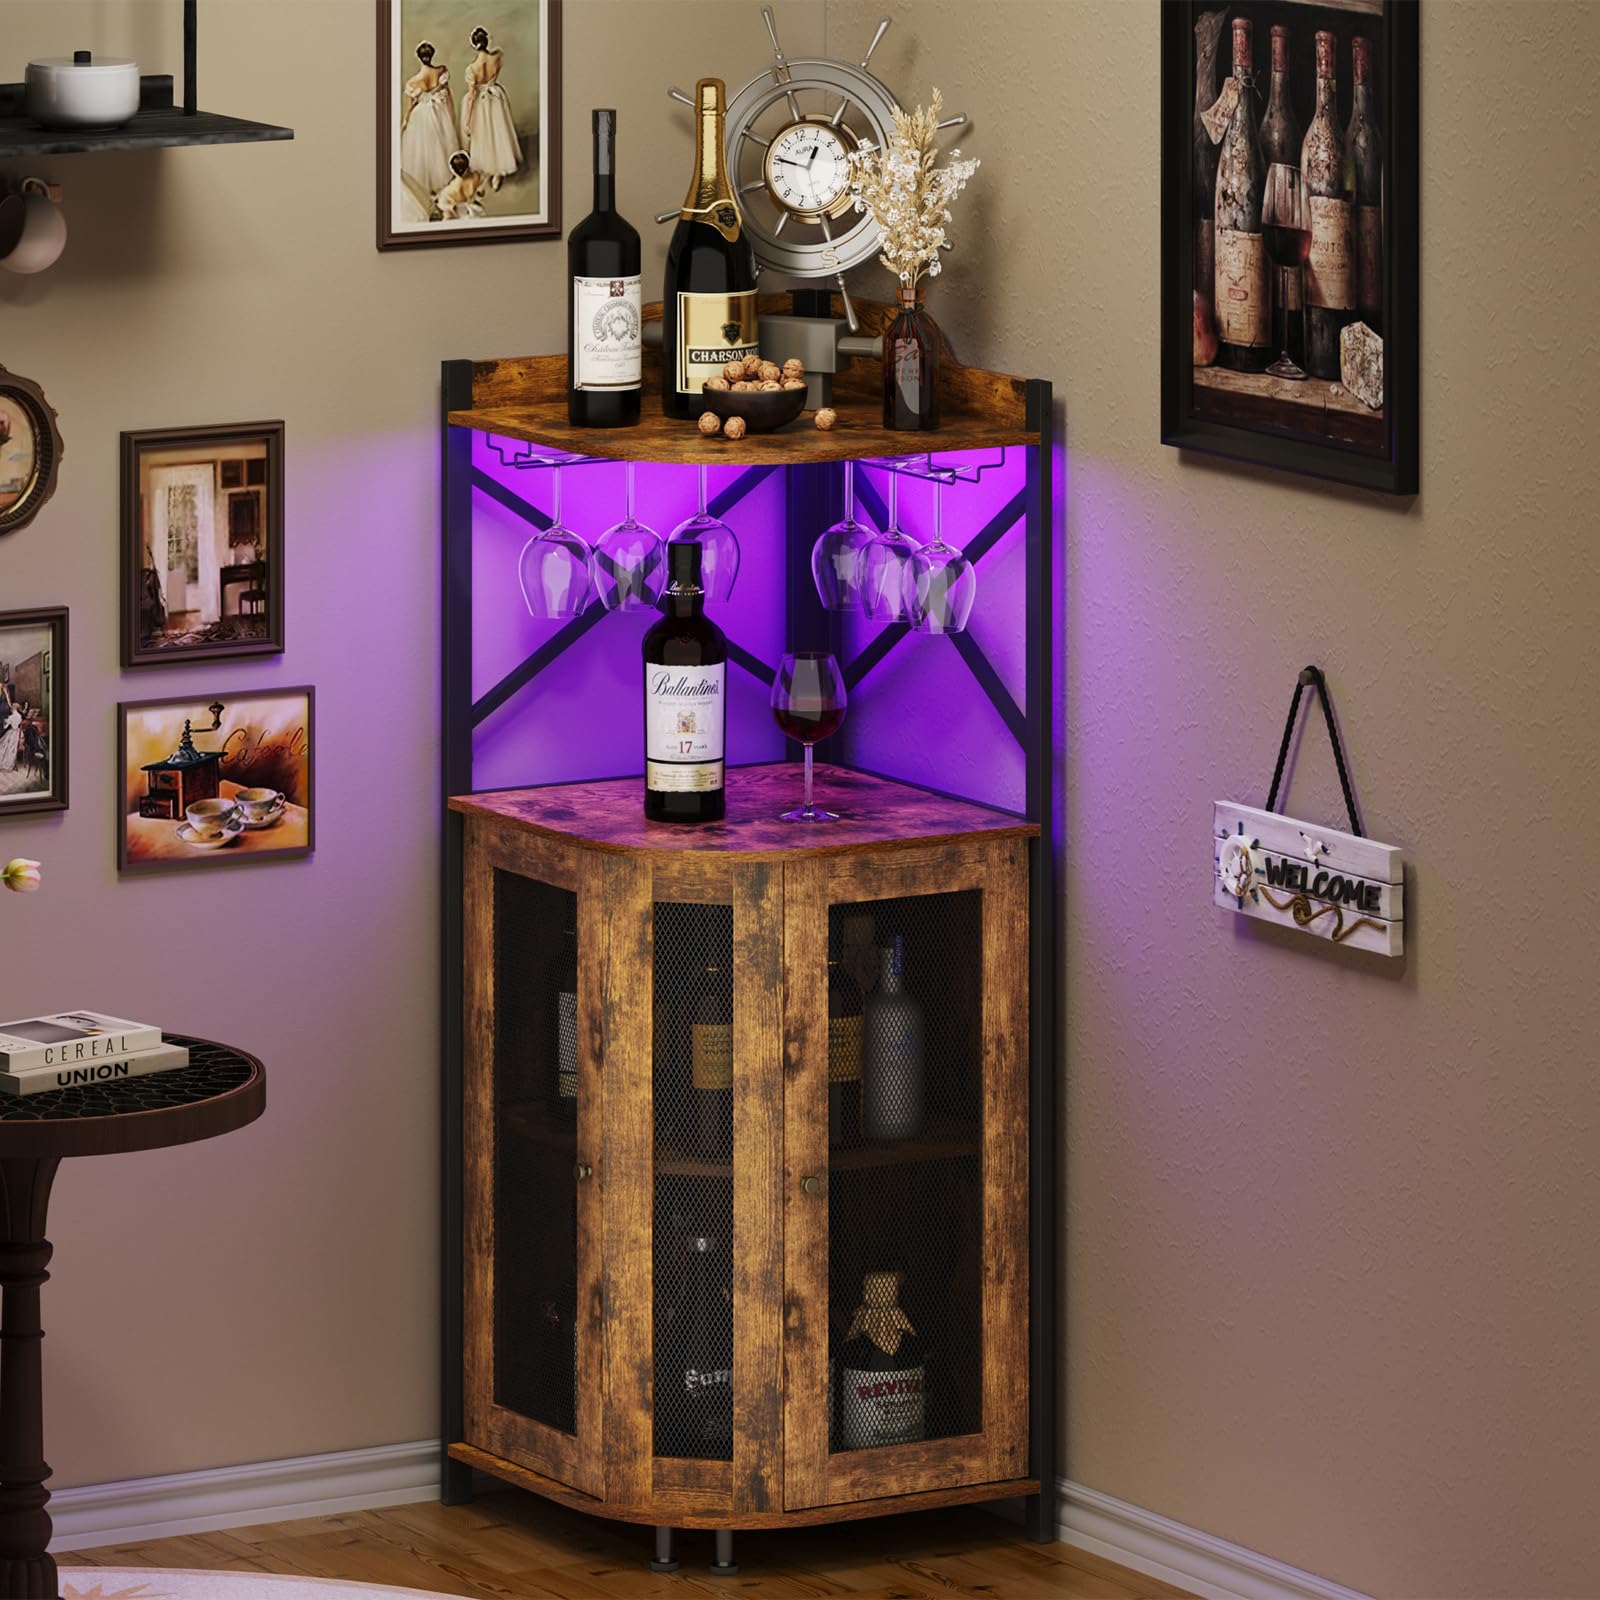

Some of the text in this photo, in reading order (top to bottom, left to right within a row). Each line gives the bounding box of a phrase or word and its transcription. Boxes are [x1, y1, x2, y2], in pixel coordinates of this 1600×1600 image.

[771, 62, 792, 86] N
[794, 129, 806, 140] 12
[780, 138, 791, 150] 11
[828, 139, 837, 147] 2
[773, 154, 781, 166] 10
[774, 175, 782, 183] 9
[783, 190, 791, 199] 8
[798, 198, 805, 207] 7
[821, 247, 840, 269] S
[691, 350, 744, 362] CHARSON
[679, 741, 693, 754] 17
[1265, 857, 1382, 912] WELCOME
[45, 1036, 128, 1064] CEREAL
[57, 1062, 129, 1086] UNION
